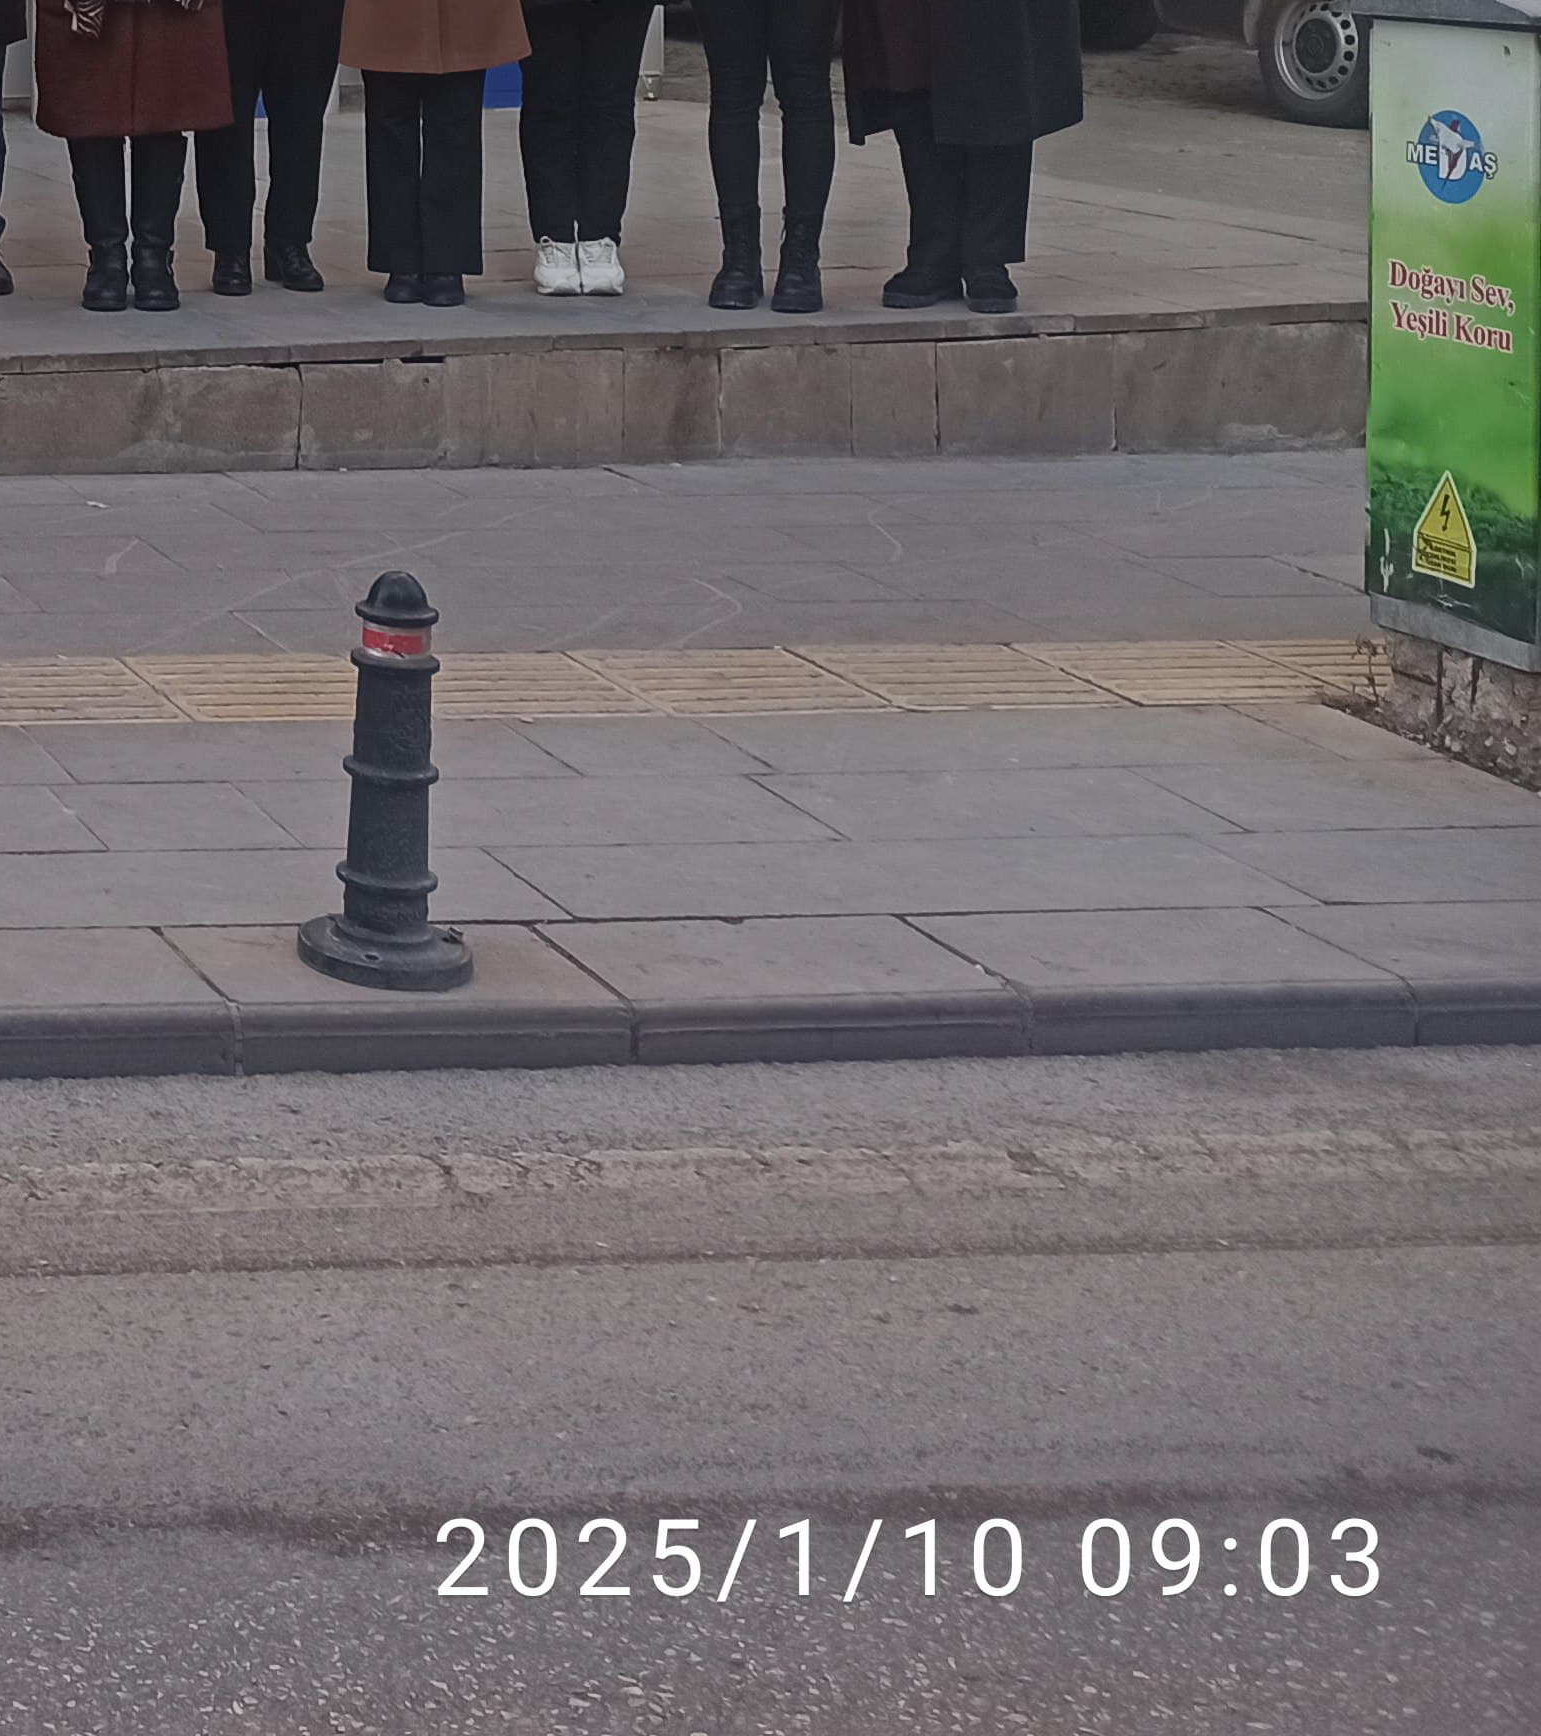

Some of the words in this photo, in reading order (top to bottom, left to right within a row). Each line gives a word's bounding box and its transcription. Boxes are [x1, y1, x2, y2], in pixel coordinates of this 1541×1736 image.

[1389, 260, 1466, 305] Doğayı
[1471, 274, 1515, 315] Sev,
[1390, 301, 1448, 339] Yeşili
[1454, 314, 1512, 352] Koru
